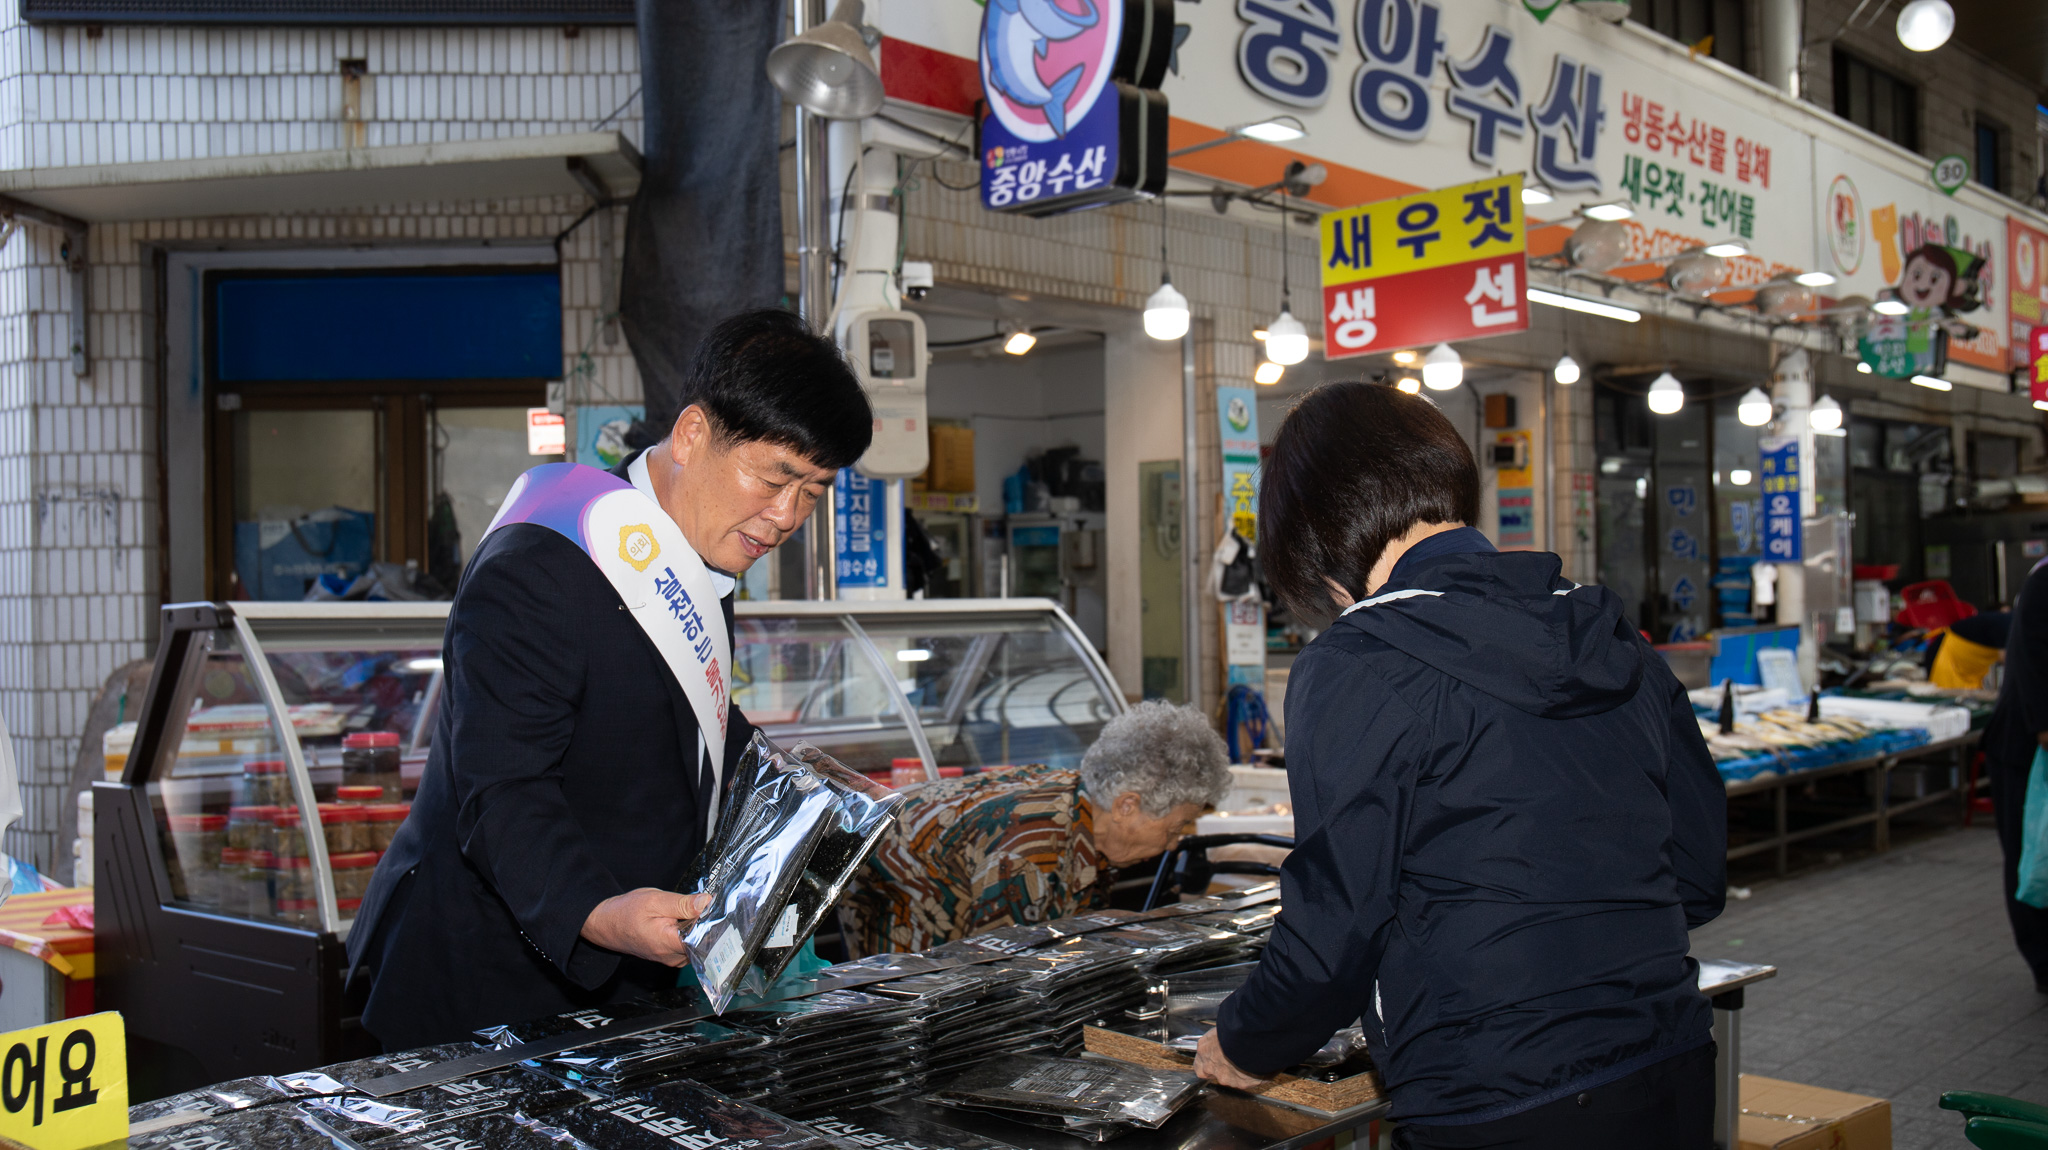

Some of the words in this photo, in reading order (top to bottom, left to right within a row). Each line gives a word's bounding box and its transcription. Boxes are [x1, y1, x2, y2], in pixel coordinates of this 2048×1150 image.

[1237, 0, 1606, 193] 중앙수산
[989, 145, 1107, 207] 중앙수산
[1622, 90, 1727, 175] 냉동수산물
[1734, 135, 1772, 190] 일체
[1940, 164, 1964, 182] 30
[1327, 185, 1515, 271] 새우젓
[1328, 263, 1519, 348] 생선
[630, 535, 650, 557] 의회
[1769, 494, 1793, 559] 오케이
[654, 567, 713, 664] 실천하는
[2, 1029, 100, 1127] 어요
[610, 1103, 729, 1150] 재래김
